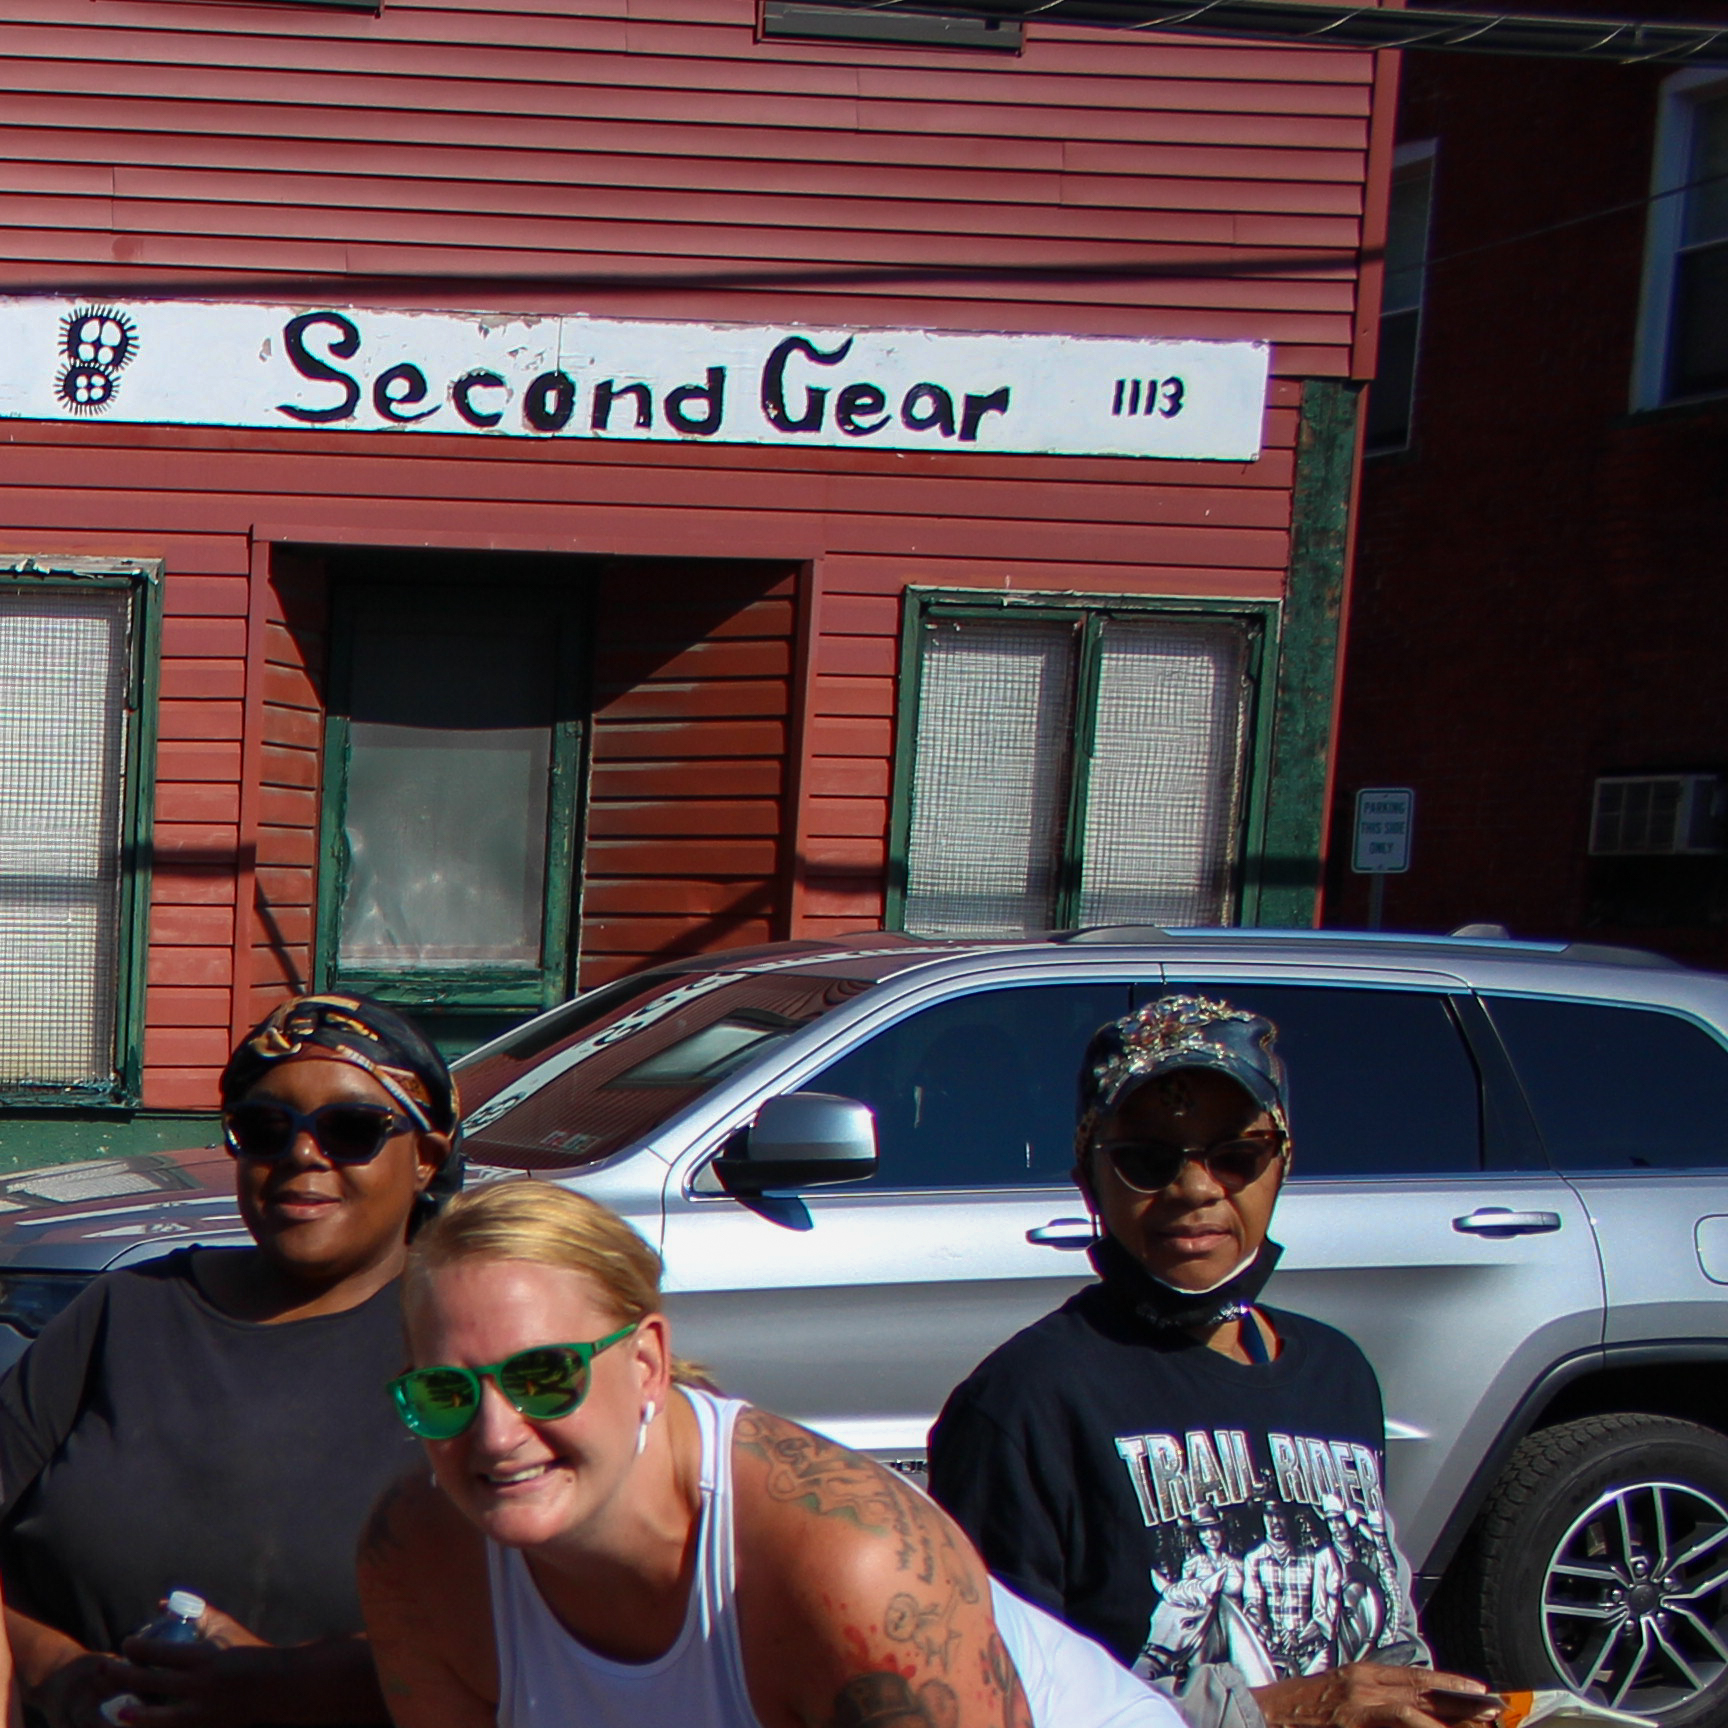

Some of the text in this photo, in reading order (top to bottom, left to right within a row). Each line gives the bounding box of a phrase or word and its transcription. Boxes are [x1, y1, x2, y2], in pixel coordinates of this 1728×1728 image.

[275, 310, 1010, 442] Second Gear
[1111, 377, 1185, 419] 1113
[1114, 1429, 1263, 1527] TRAIL
